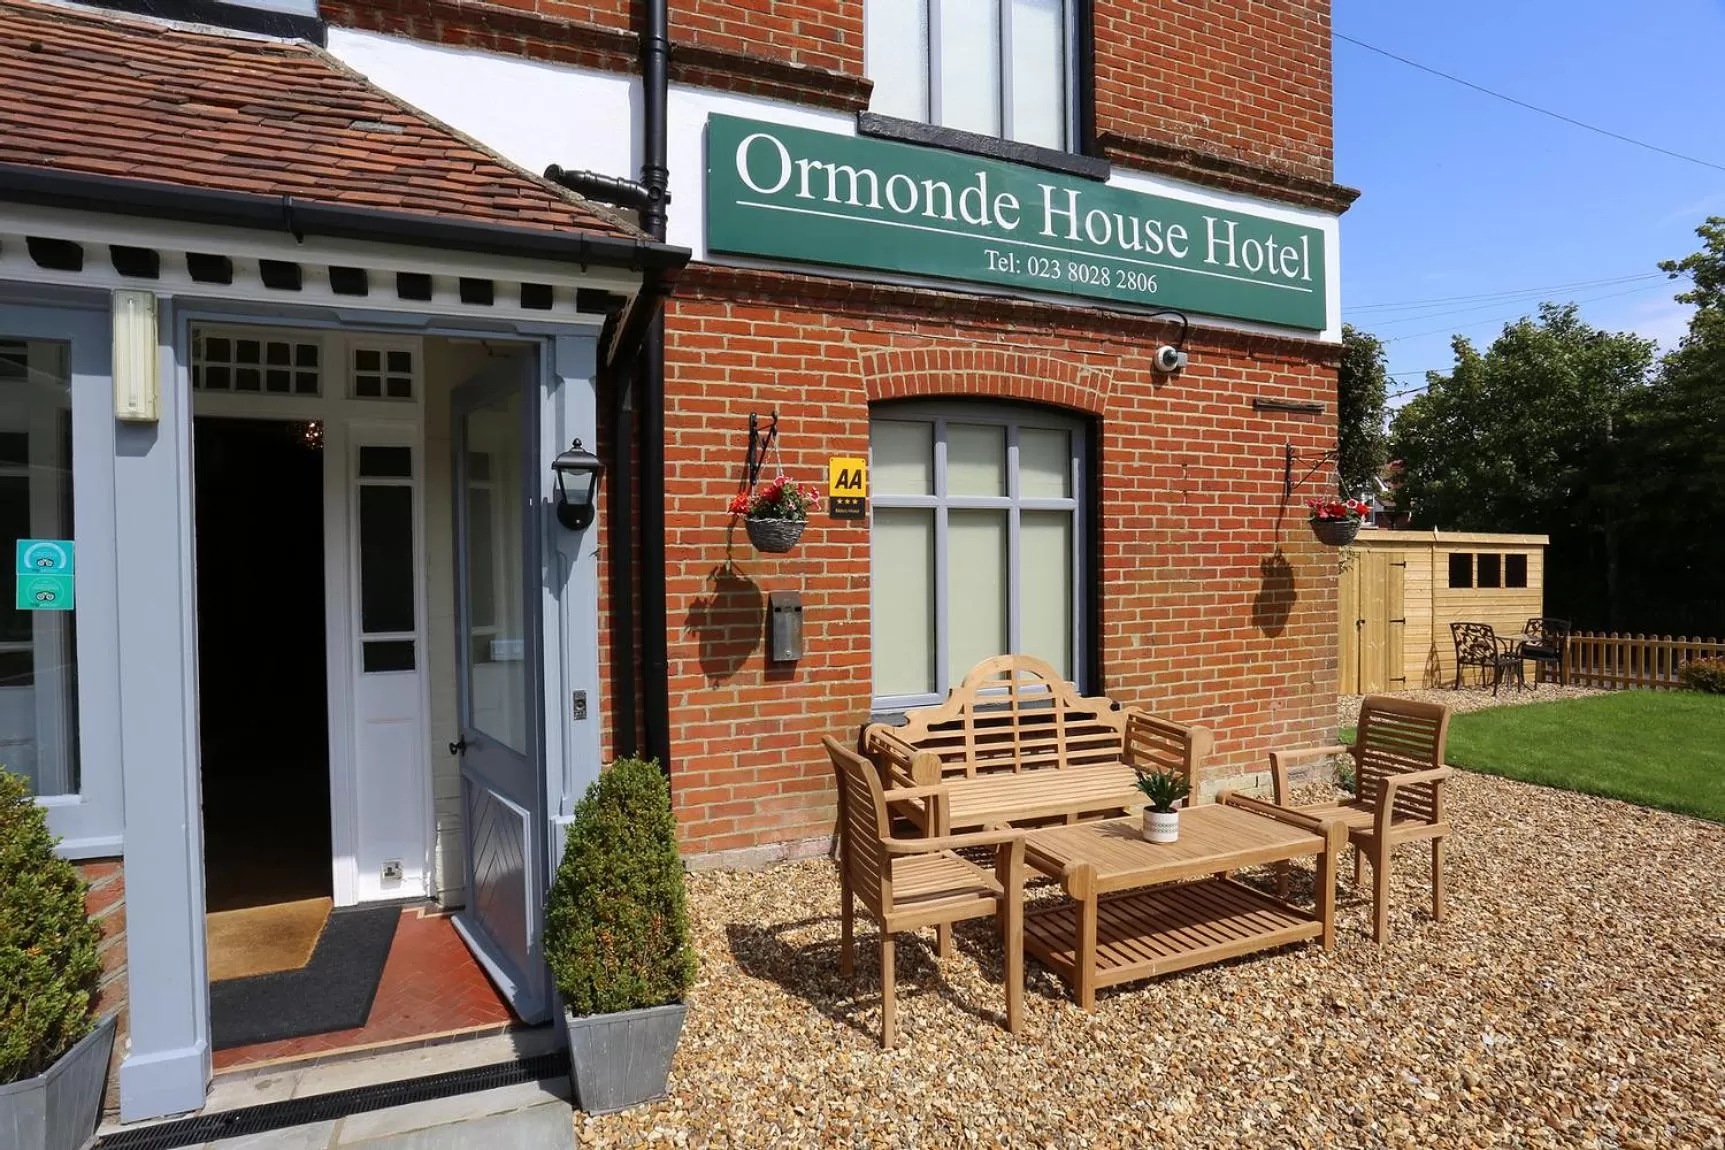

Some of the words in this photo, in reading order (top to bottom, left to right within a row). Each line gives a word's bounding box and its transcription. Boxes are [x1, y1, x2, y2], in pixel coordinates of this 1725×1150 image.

[735, 132, 1021, 231] Ormonde
[1036, 183, 1189, 259] House
[1201, 215, 1313, 282] Hotel
[983, 249, 1021, 274] Tel:
[1027, 255, 1062, 280] 023
[1067, 261, 1111, 287] 8028
[1115, 269, 1158, 294] 2806
[835, 468, 862, 490] AA
